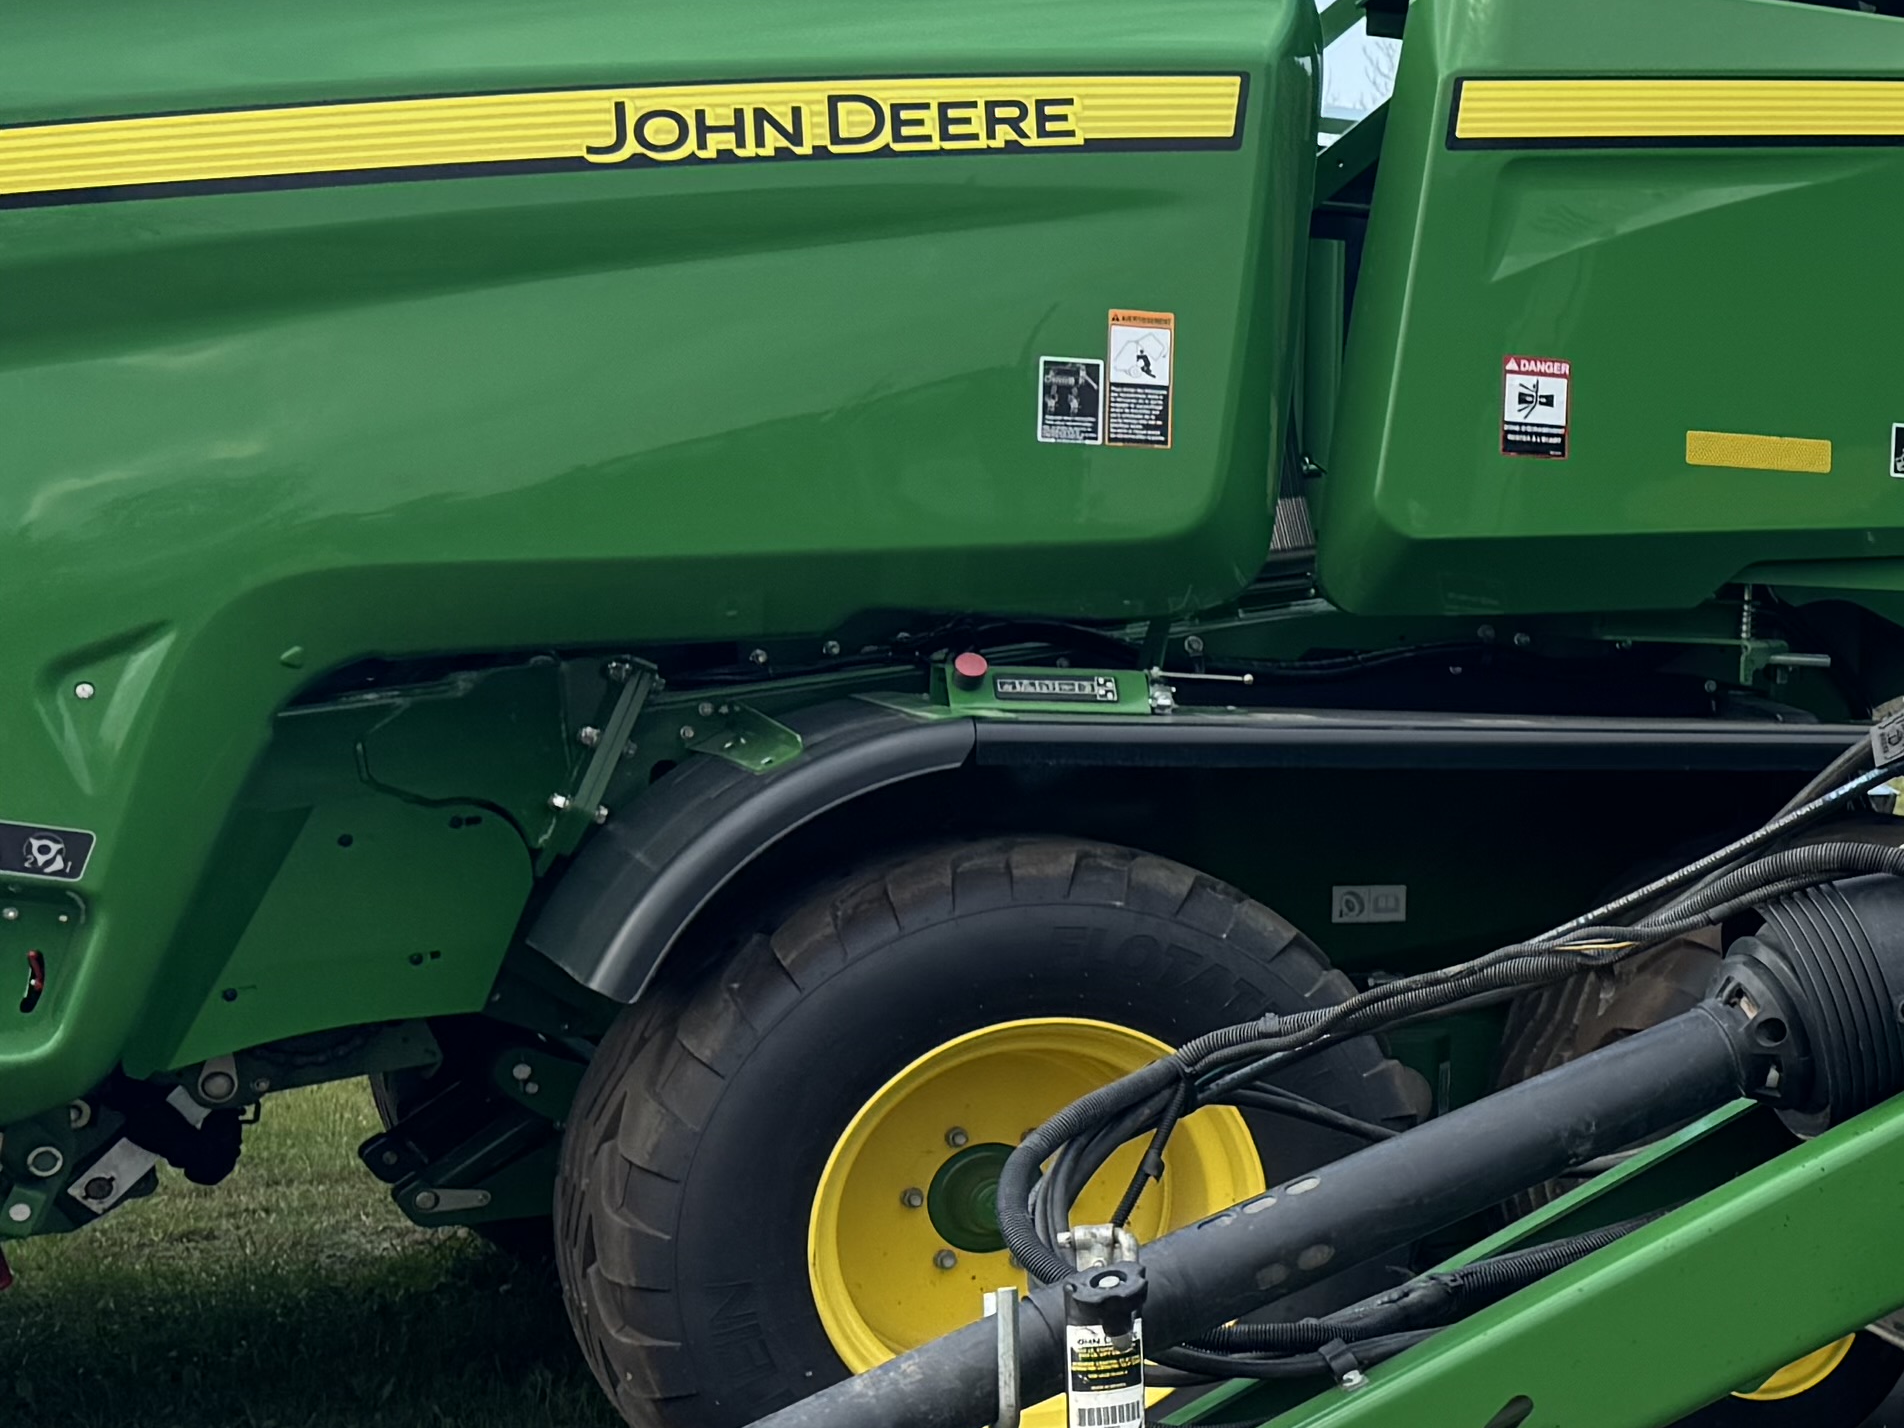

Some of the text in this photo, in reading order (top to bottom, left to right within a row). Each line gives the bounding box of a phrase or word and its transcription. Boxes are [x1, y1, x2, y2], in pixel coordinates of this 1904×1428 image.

[586, 93, 1076, 155] JOHN DEERE
[1520, 359, 1570, 375] DANGER
